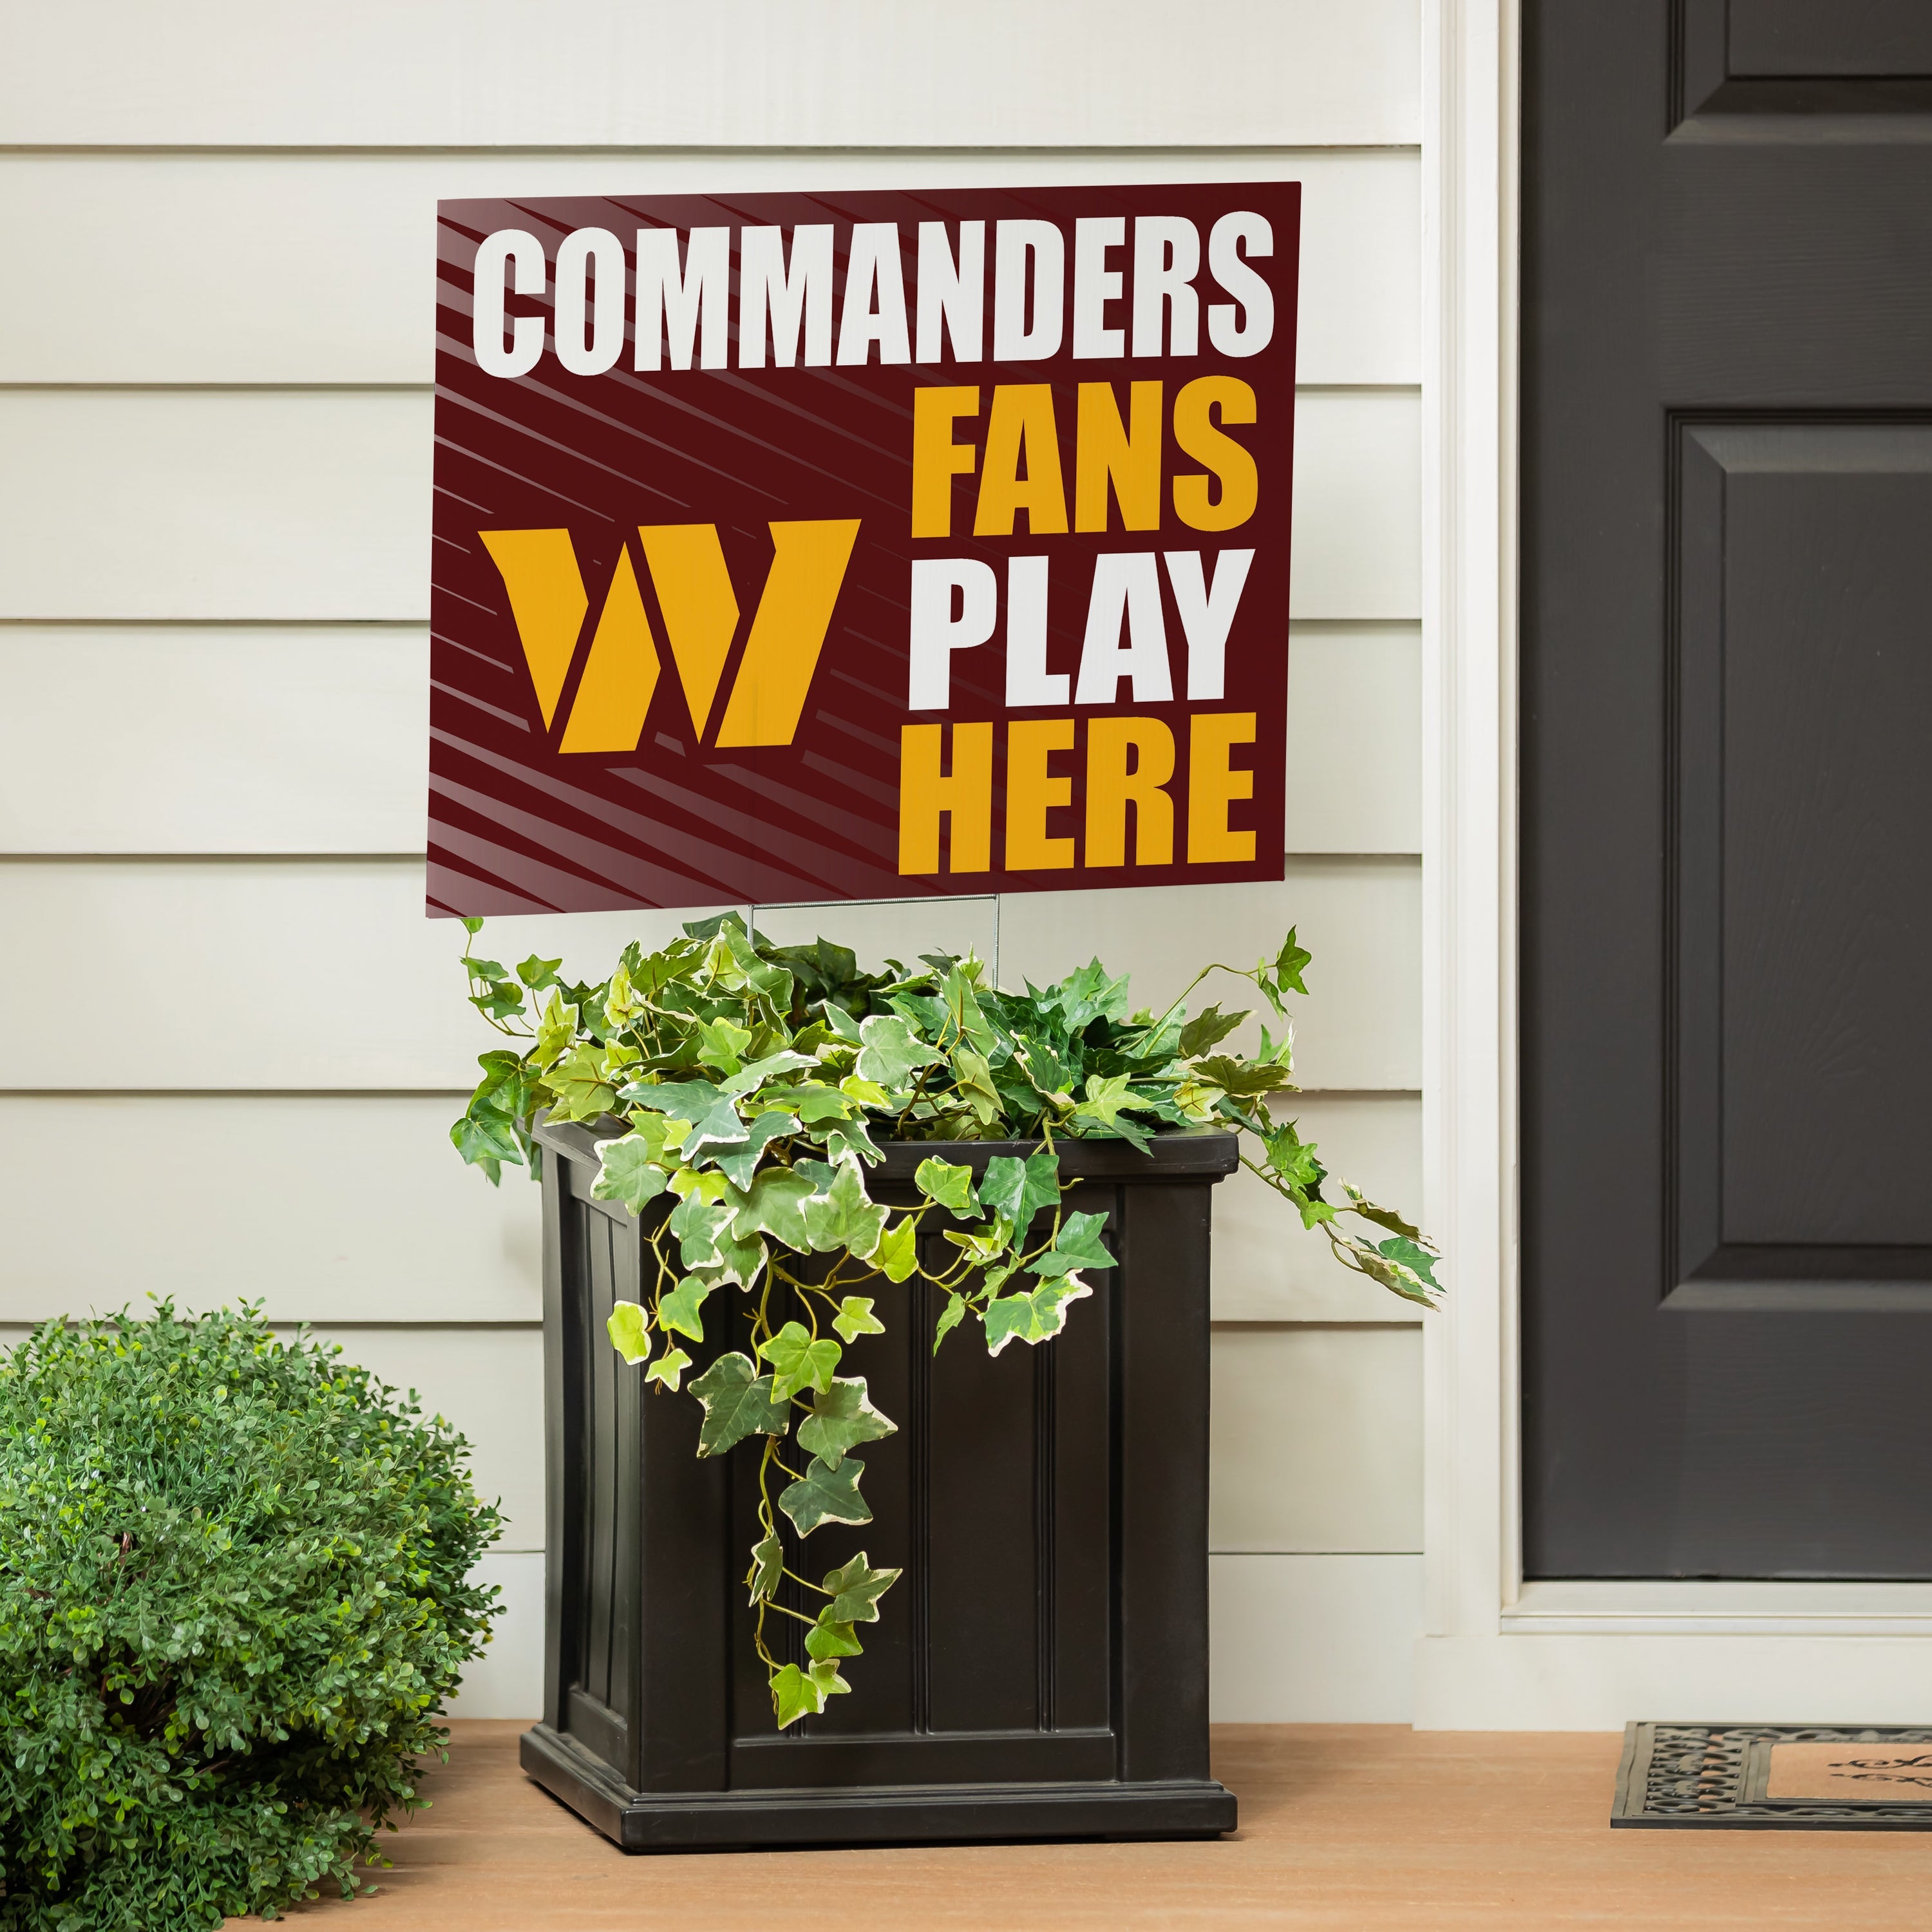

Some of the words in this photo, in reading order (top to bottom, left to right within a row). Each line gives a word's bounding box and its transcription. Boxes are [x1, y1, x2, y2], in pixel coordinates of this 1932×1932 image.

[473, 211, 1274, 378] COMMANDERS
[912, 376, 1258, 538] FANS
[478, 519, 862, 753] W
[909, 549, 1256, 710] PLAY
[899, 713, 1256, 875] HERE
